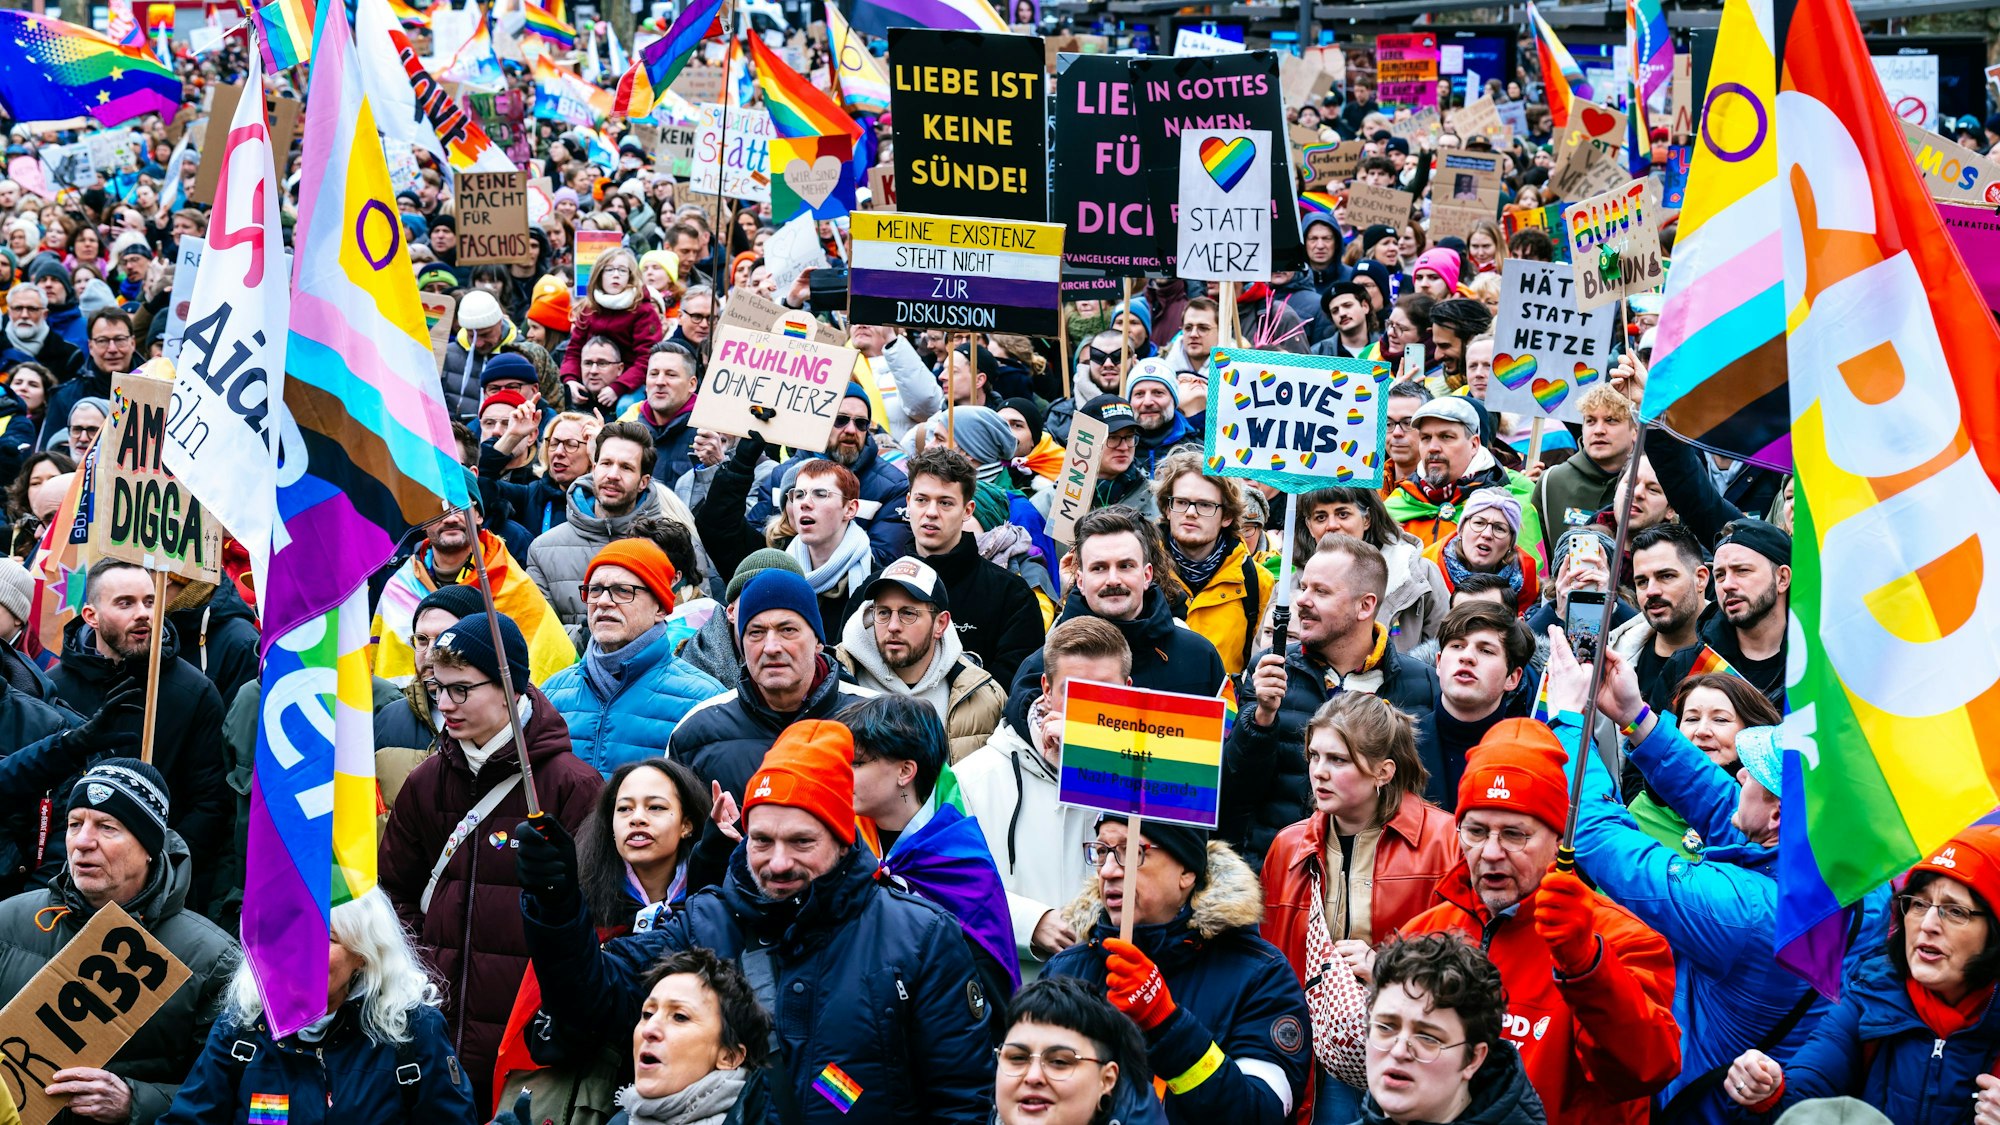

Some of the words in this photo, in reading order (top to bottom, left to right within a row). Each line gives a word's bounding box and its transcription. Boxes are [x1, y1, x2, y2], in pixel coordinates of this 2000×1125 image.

[896, 64, 979, 96] LIEBE
[991, 71, 1038, 99] IST
[1146, 80, 1170, 102] IN
[1177, 74, 1268, 101] GOTTES
[1077, 81, 1136, 116] LIE
[923, 114, 1013, 146] KEINE
[1311, 153, 1342, 164] Jeder
[911, 154, 1027, 194] SÜNDE!
[460, 191, 524, 209] MACHT
[463, 211, 492, 226] FÜR
[1191, 207, 1266, 232] STATT
[1572, 183, 1644, 254] BUNT
[459, 233, 526, 258] FASCHOS
[877, 220, 934, 241] MEINE
[950, 224, 1036, 249] EXISTENZ
[895, 246, 947, 270] STEHT
[953, 251, 994, 273] NICHT
[1183, 242, 1260, 273] MERZ
[931, 277, 969, 299] ZUR
[1096, 278, 1116, 288] KÖLN
[896, 301, 996, 329] DISKUSSION
[1521, 302, 1593, 327] STATT
[1514, 328, 1596, 356] HETZE
[712, 368, 771, 404] OHNE
[775, 381, 838, 418] MERZ
[1249, 380, 1343, 418] LOVE
[1777, 90, 2000, 718] SPD
[1246, 417, 1339, 453] WINS
[1060, 429, 1095, 521] MENSCH
[110, 476, 203, 566] DIGGA
[1097, 713, 1184, 738] Regenbogen
[1120, 748, 1153, 763] statt
[754, 787, 772, 799] SPD
[1486, 787, 1511, 800] SPD
[1931, 855, 1957, 869] SPD
[36, 926, 168, 1054] 1933
[1128, 979, 1151, 1004] MACH
[1143, 976, 1162, 1004] SPD
[1502, 1014, 1530, 1037] PD
